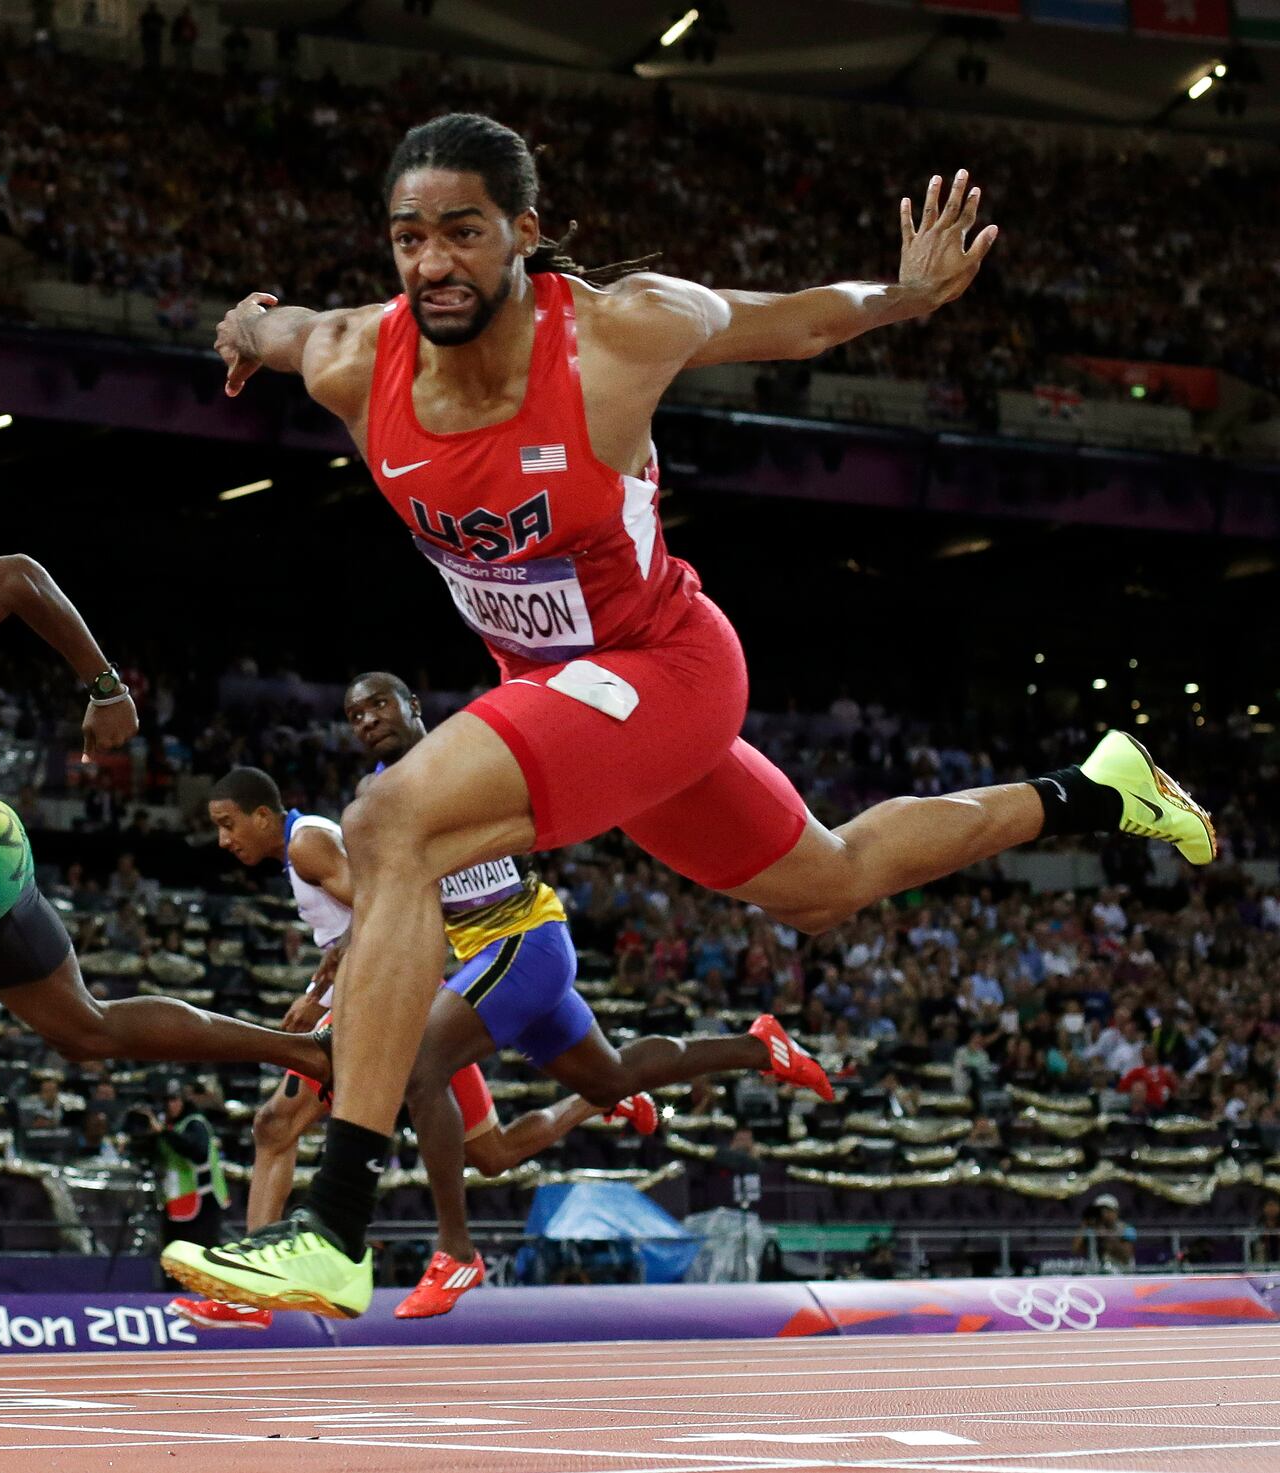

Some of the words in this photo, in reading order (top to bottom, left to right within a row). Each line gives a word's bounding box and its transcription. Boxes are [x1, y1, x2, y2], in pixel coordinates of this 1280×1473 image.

[409, 489, 552, 563] USA
[443, 553, 489, 577] London
[492, 566, 527, 581] 2012
[83, 1305, 198, 1346] 2012
